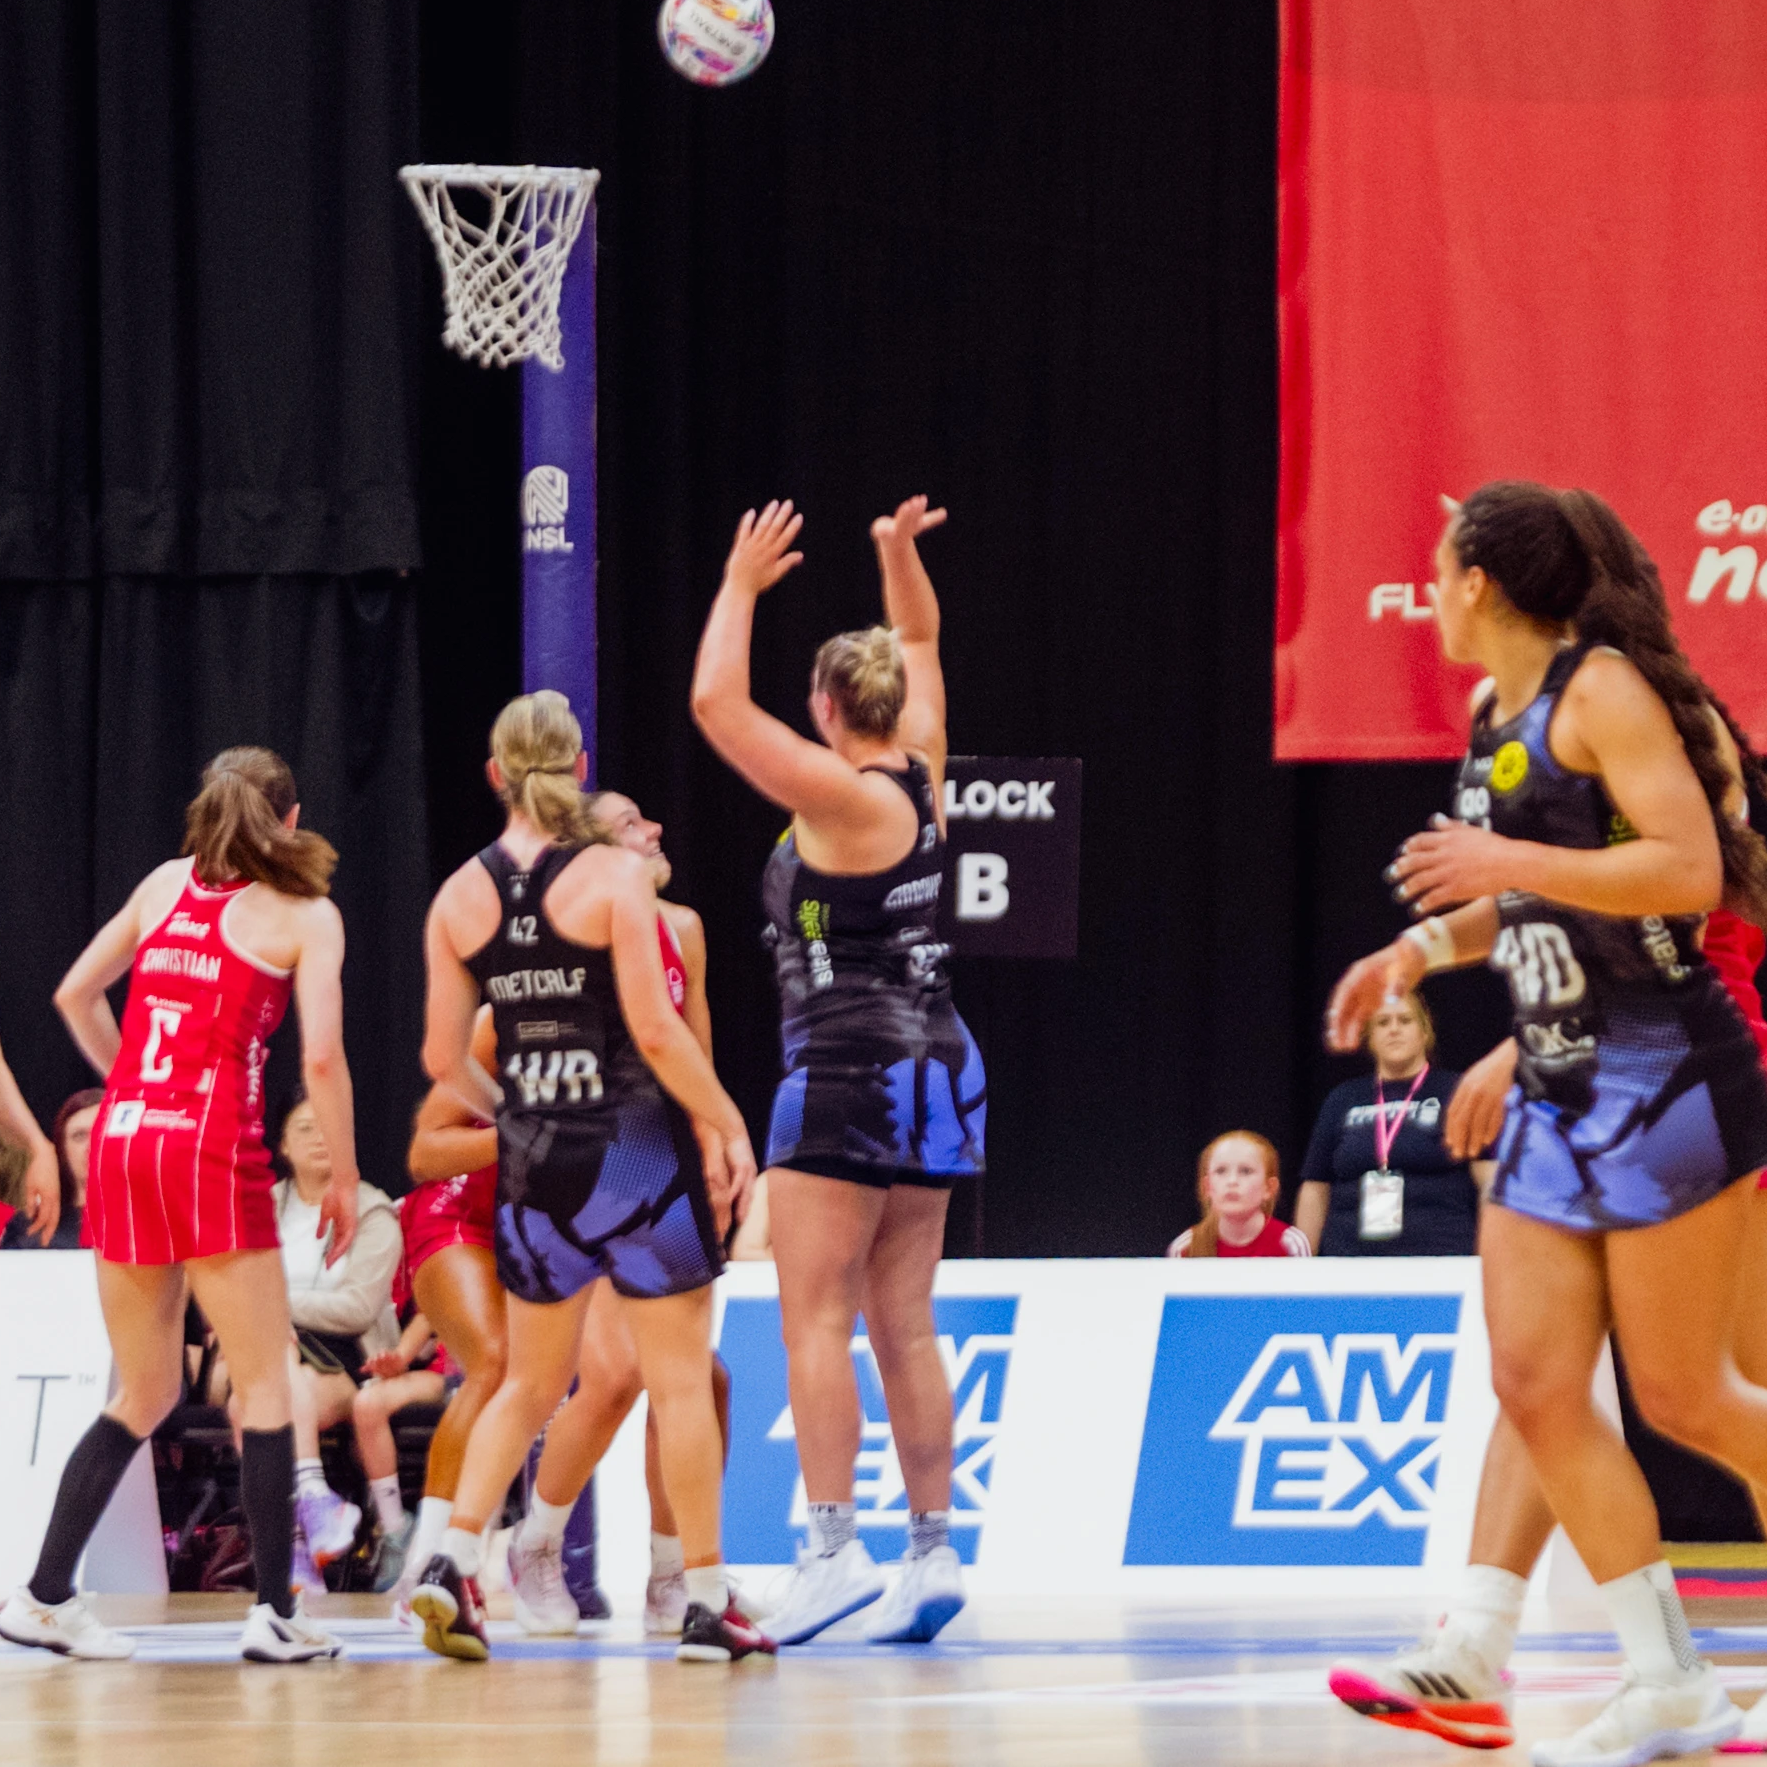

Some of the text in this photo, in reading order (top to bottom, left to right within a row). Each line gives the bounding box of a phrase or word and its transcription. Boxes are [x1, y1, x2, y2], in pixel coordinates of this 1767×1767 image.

[525, 526, 574, 553] NSL
[944, 779, 1057, 819] LOCK
[956, 851, 1010, 921] B
[506, 915, 539, 947] 42
[140, 947, 222, 983] CHRISTIAN
[487, 967, 587, 1001] METCALF
